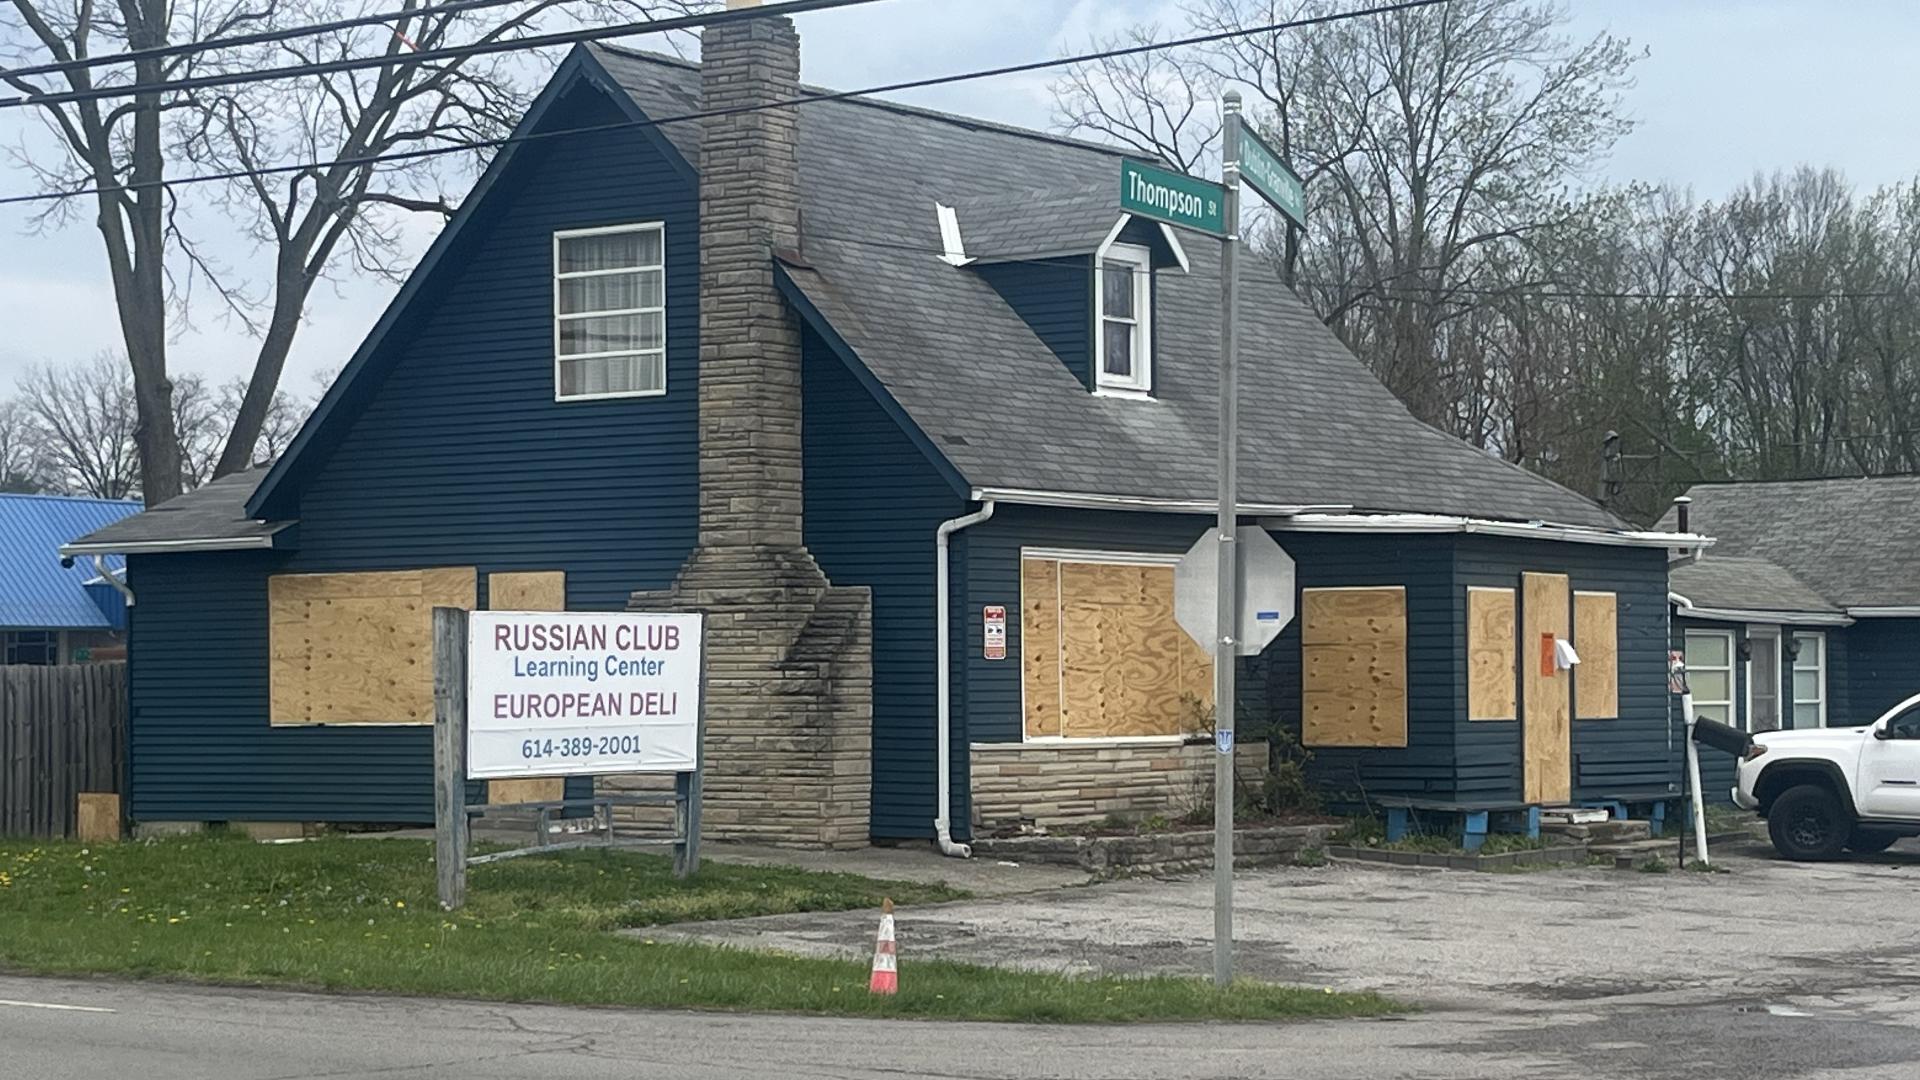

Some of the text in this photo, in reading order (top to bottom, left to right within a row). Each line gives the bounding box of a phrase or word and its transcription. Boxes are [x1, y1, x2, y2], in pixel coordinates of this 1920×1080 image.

[1128, 170, 1202, 219] Thompson
[495, 624, 680, 651] RUSSIAN CLUB
[514, 655, 665, 682] Learning Center
[494, 692, 677, 719] EUROPEAN DELI
[522, 735, 641, 759] 614-389-2001
